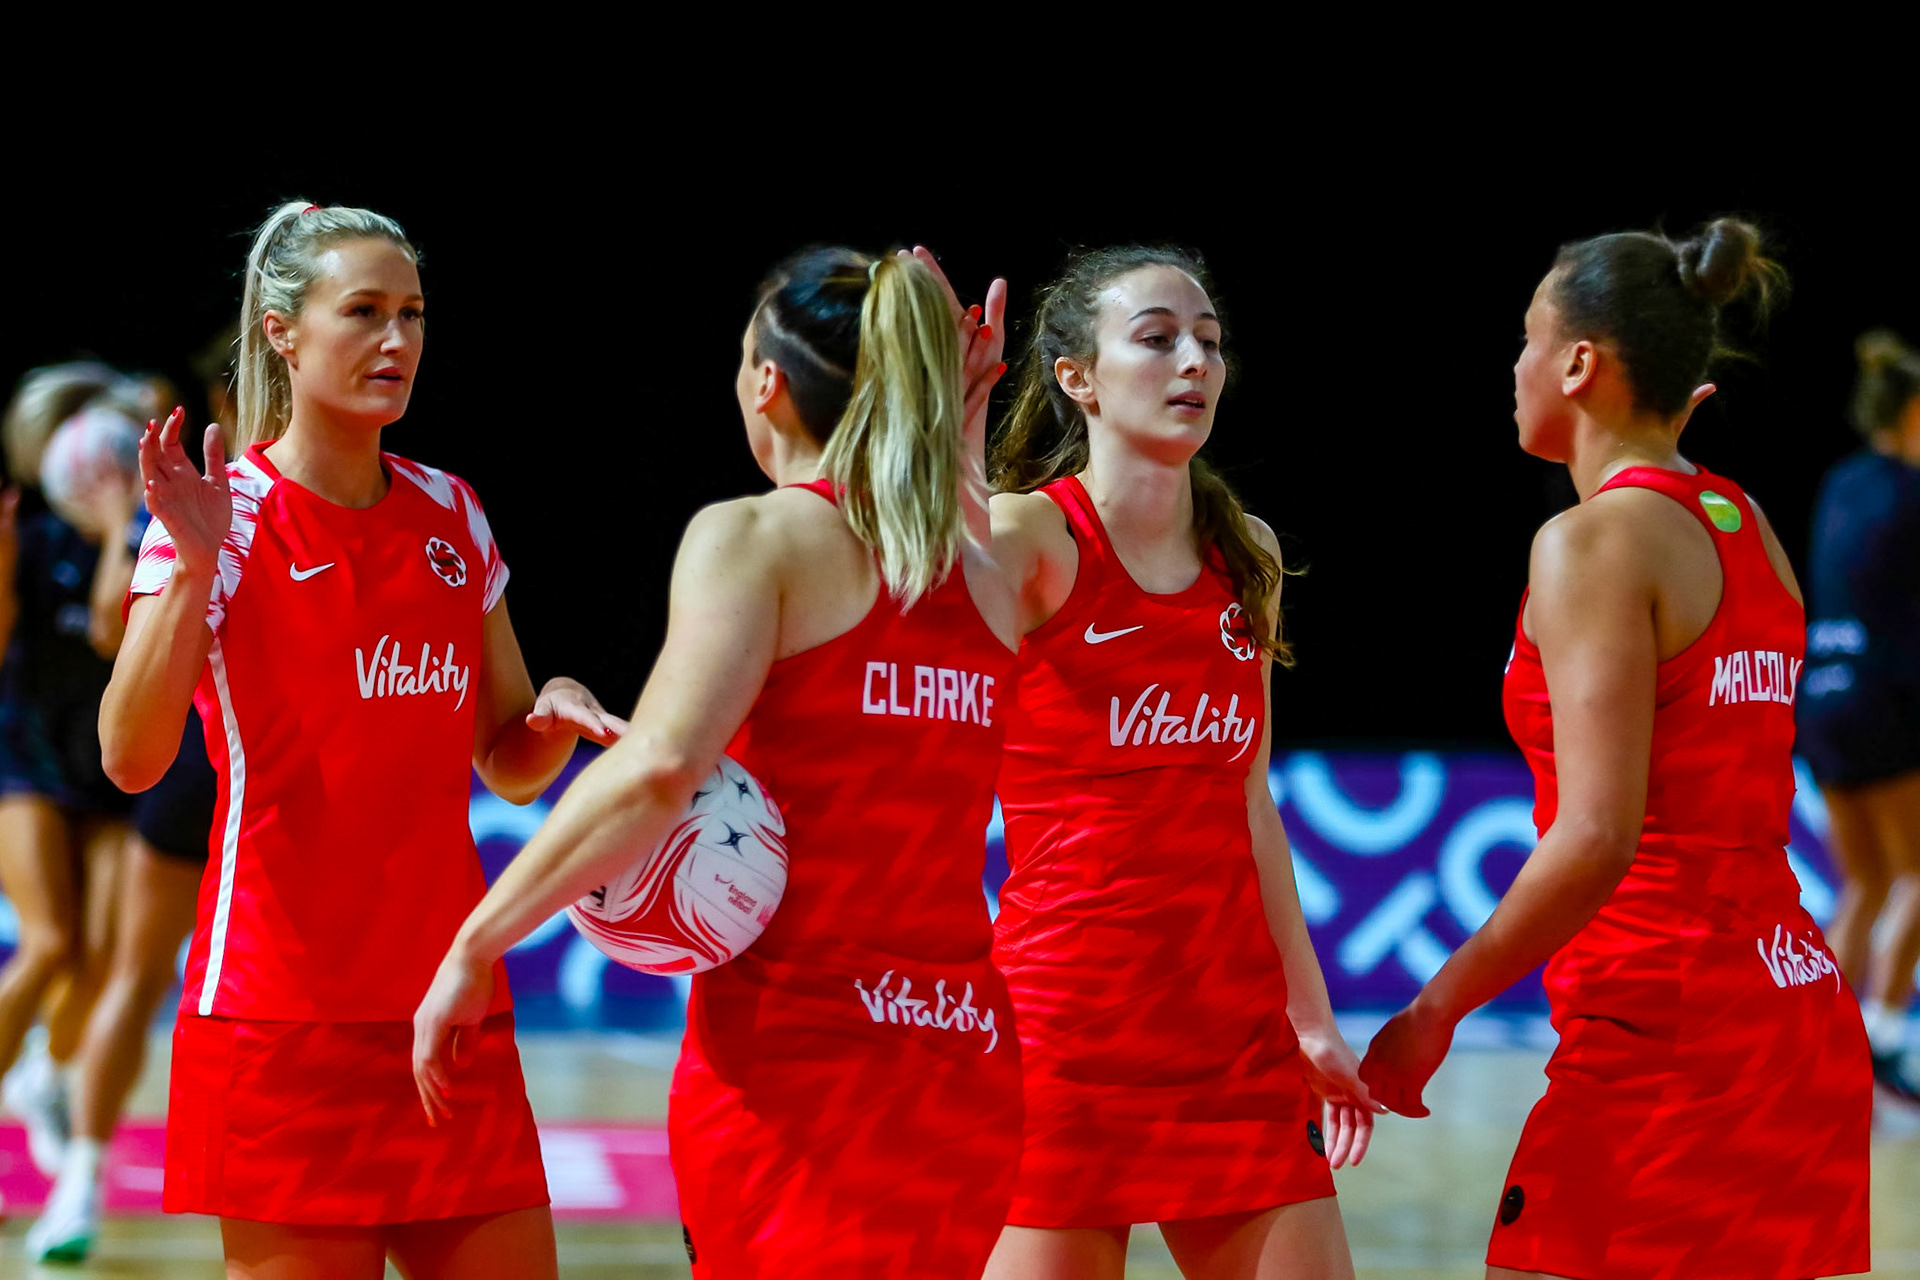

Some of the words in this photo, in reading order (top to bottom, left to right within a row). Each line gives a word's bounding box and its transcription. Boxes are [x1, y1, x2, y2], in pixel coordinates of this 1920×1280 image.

[355, 634, 470, 712] Vitality
[862, 661, 995, 728] CLARKE
[1109, 683, 1256, 763] Vitality
[854, 969, 999, 1054] Vitality
